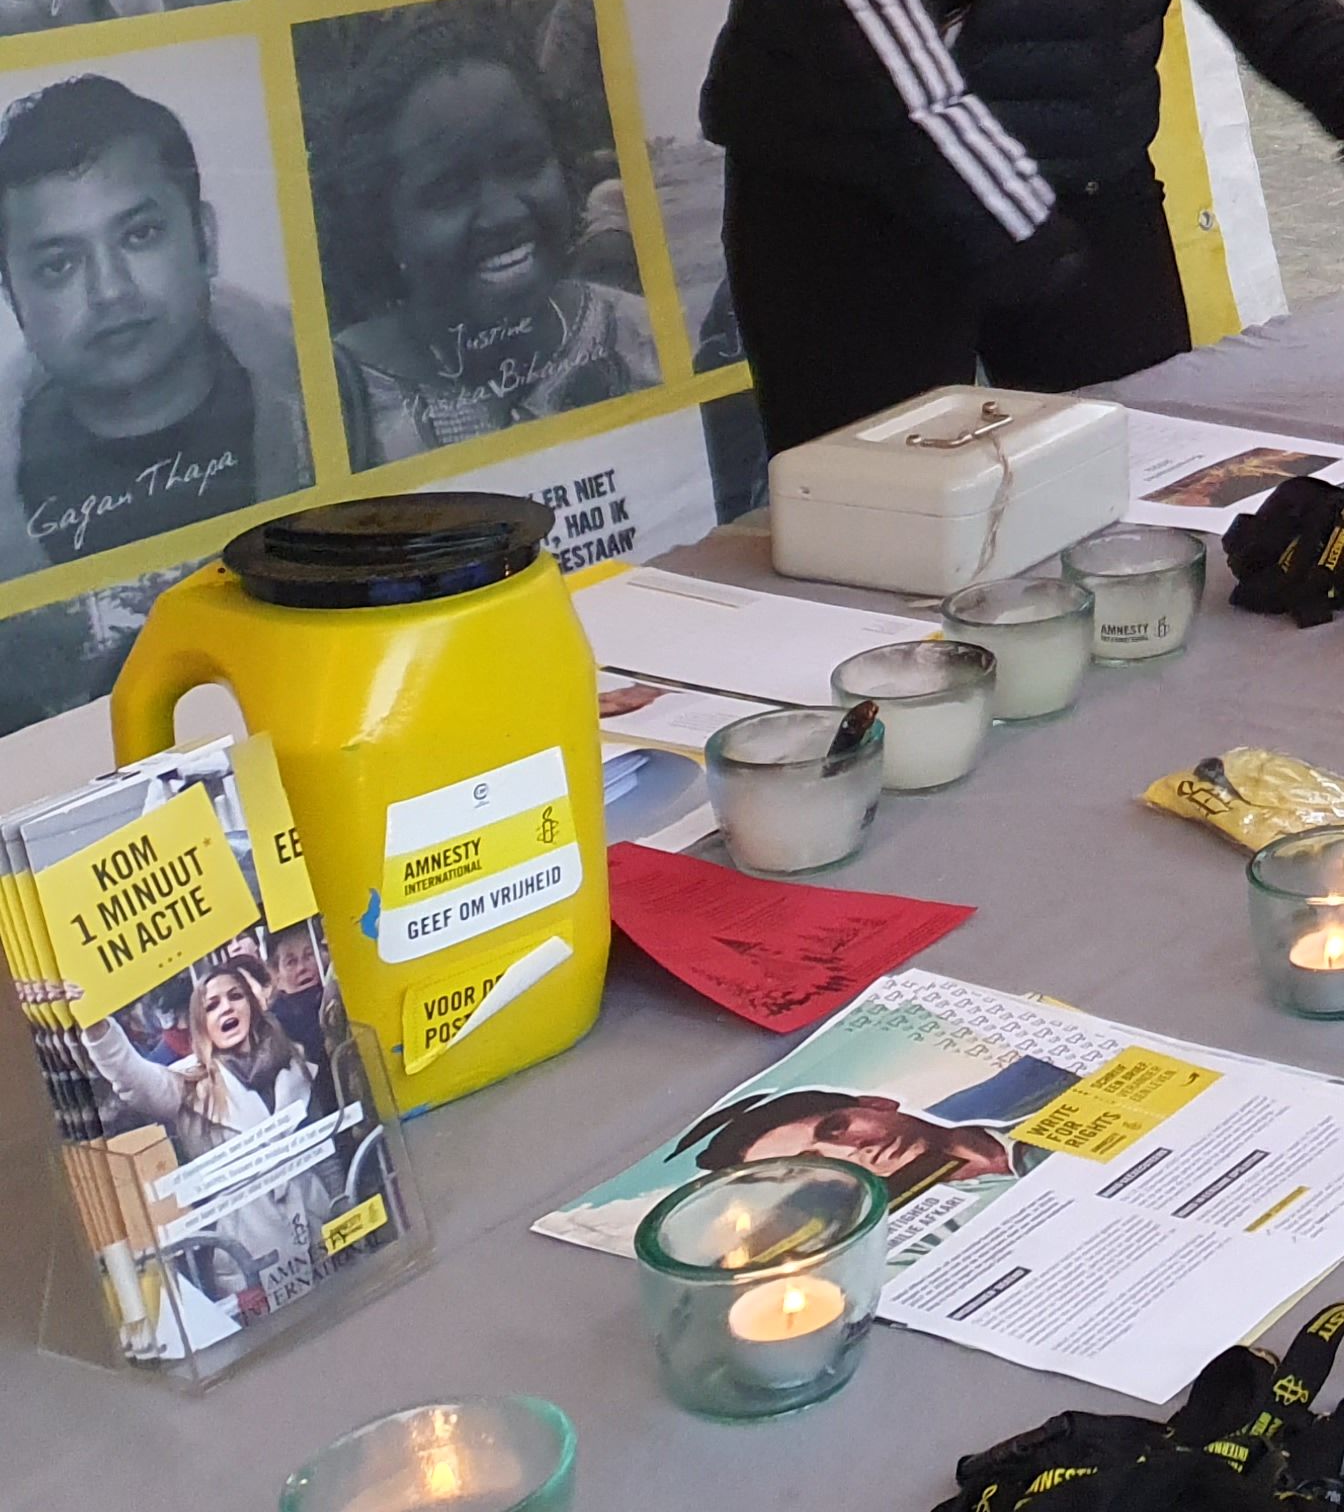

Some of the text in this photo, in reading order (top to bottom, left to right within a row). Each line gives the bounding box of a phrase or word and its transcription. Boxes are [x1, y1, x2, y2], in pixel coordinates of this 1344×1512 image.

[574, 468, 617, 503] NIET
[565, 497, 630, 539] HAD IK
[552, 525, 637, 575] ESTAAN'
[1101, 623, 1149, 636] AMNESTY
[91, 834, 158, 893] KOM
[404, 838, 482, 882] AMNESTY
[404, 858, 483, 897] INTERNATIONAL
[70, 845, 204, 947] 1 MINUUT
[407, 865, 562, 941] GEEF OM VRIJHEID
[96, 884, 213, 974] IN ACTIE
[423, 985, 476, 1021] VOOR
[1026, 1102, 1080, 1137] WRITE
[1045, 1119, 1084, 1144] FOR
[1065, 1110, 1122, 1149] RIGHTS
